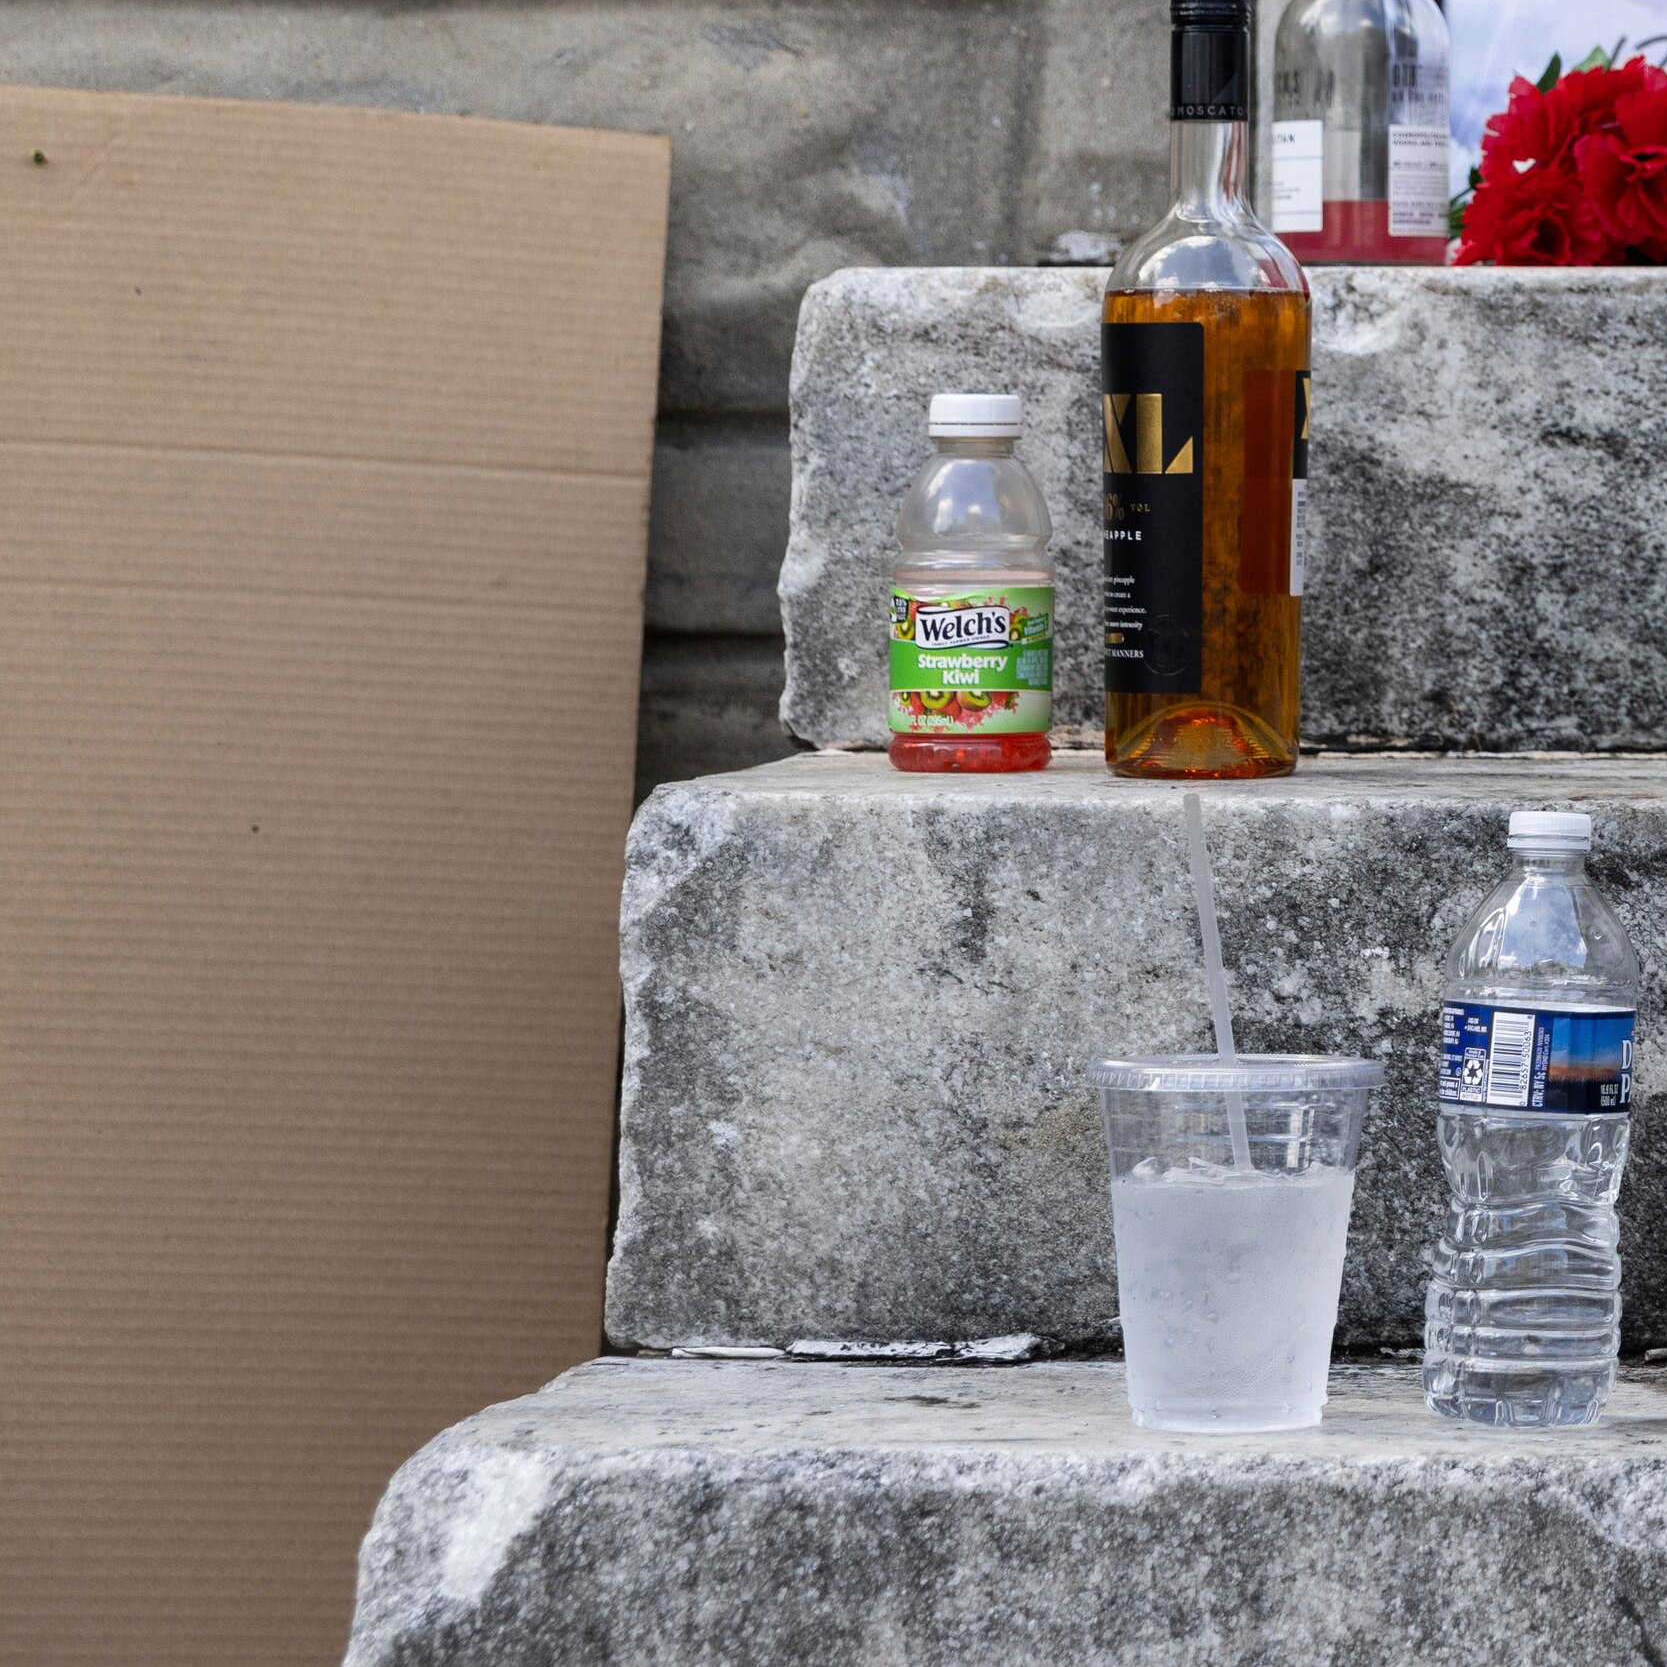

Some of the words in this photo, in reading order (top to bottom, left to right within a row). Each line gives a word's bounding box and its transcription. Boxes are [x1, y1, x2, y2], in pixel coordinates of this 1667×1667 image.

[919, 611, 1006, 642] Welch's
[918, 653, 1008, 672] Strawberry
[943, 669, 980, 685] Kiwi
